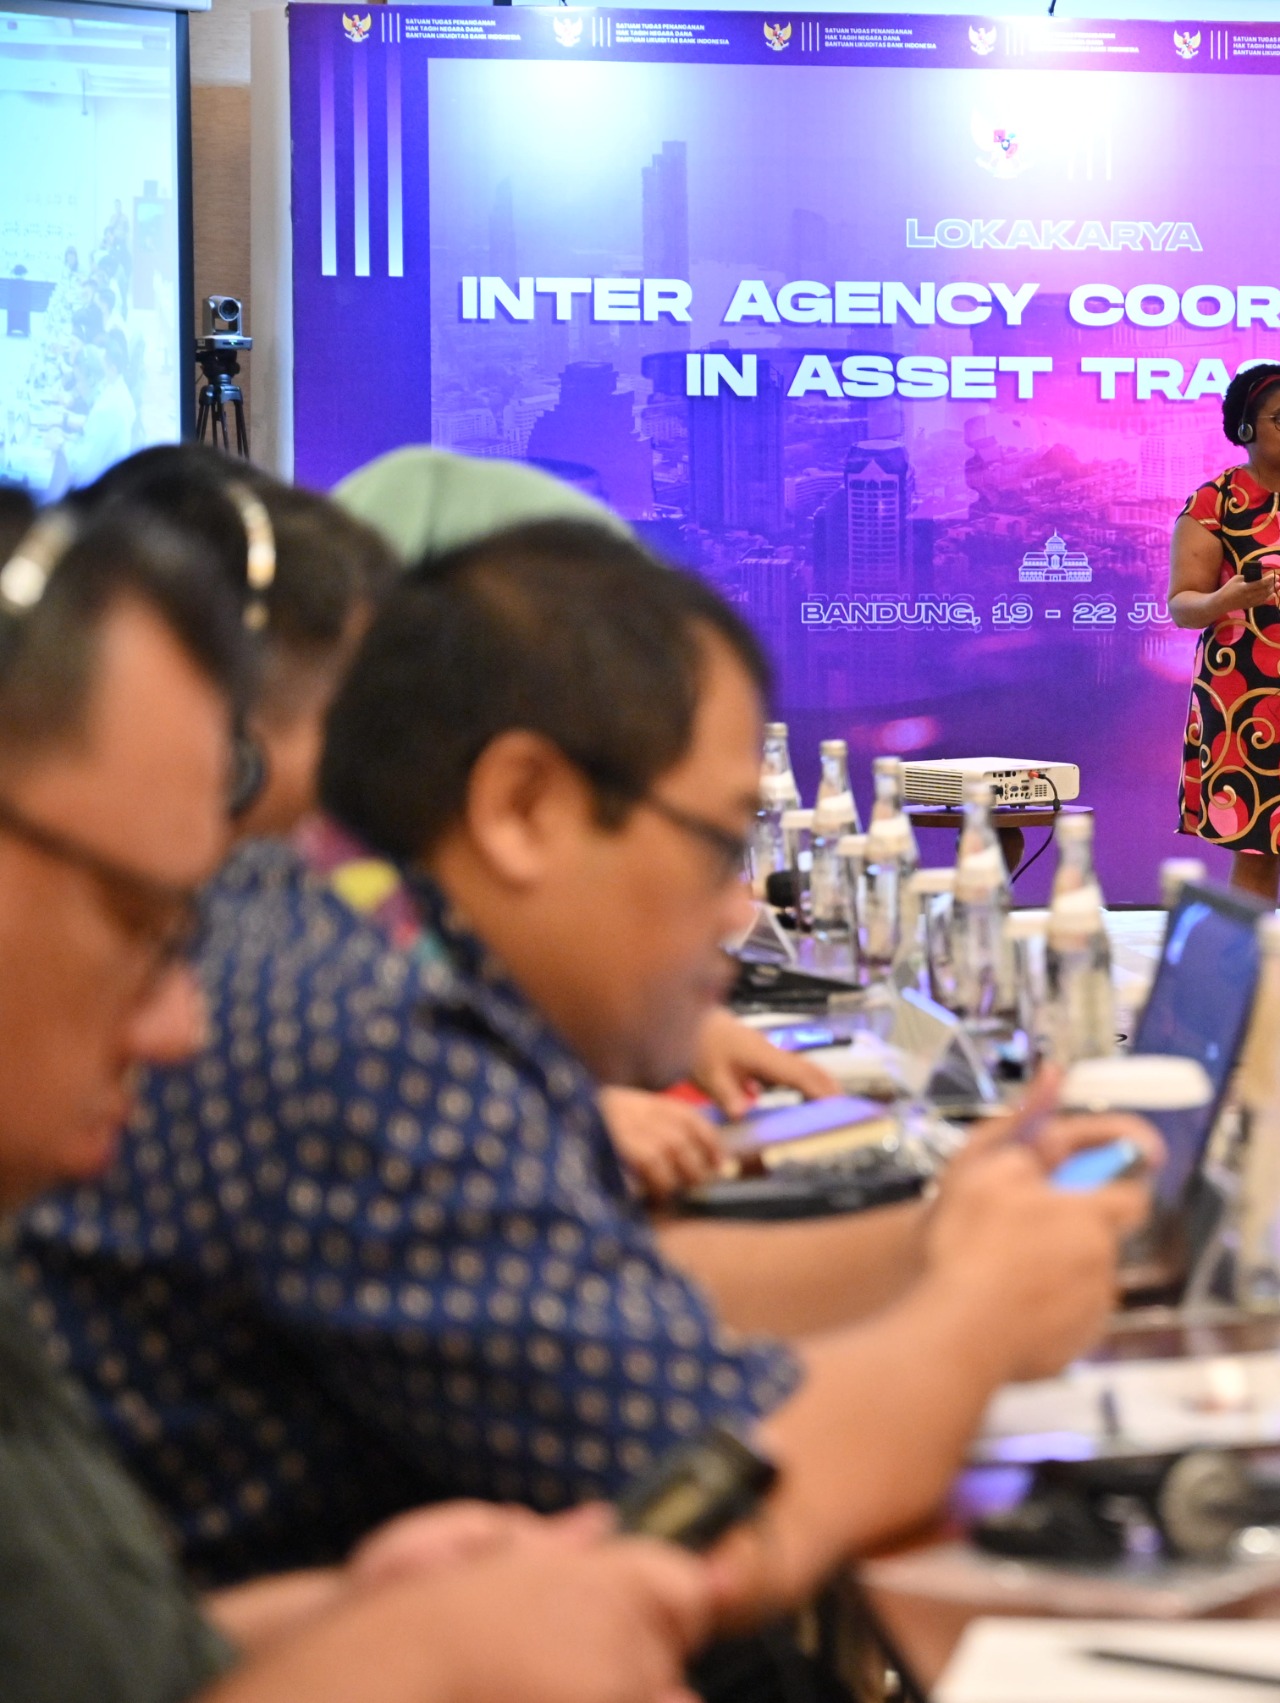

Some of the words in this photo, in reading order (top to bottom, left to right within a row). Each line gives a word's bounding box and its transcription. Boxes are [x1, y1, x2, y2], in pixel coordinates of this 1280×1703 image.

[906, 218, 1203, 251] LOKAKARYA
[462, 276, 693, 322] INTER
[723, 280, 1041, 325] AGENCY
[686, 354, 757, 397] IN
[787, 355, 1053, 399] ASSET
[801, 602, 981, 627] BANDUNG,
[992, 602, 1033, 624] 19
[1045, 609, 1061, 619] -
[1072, 602, 1117, 624] 22
